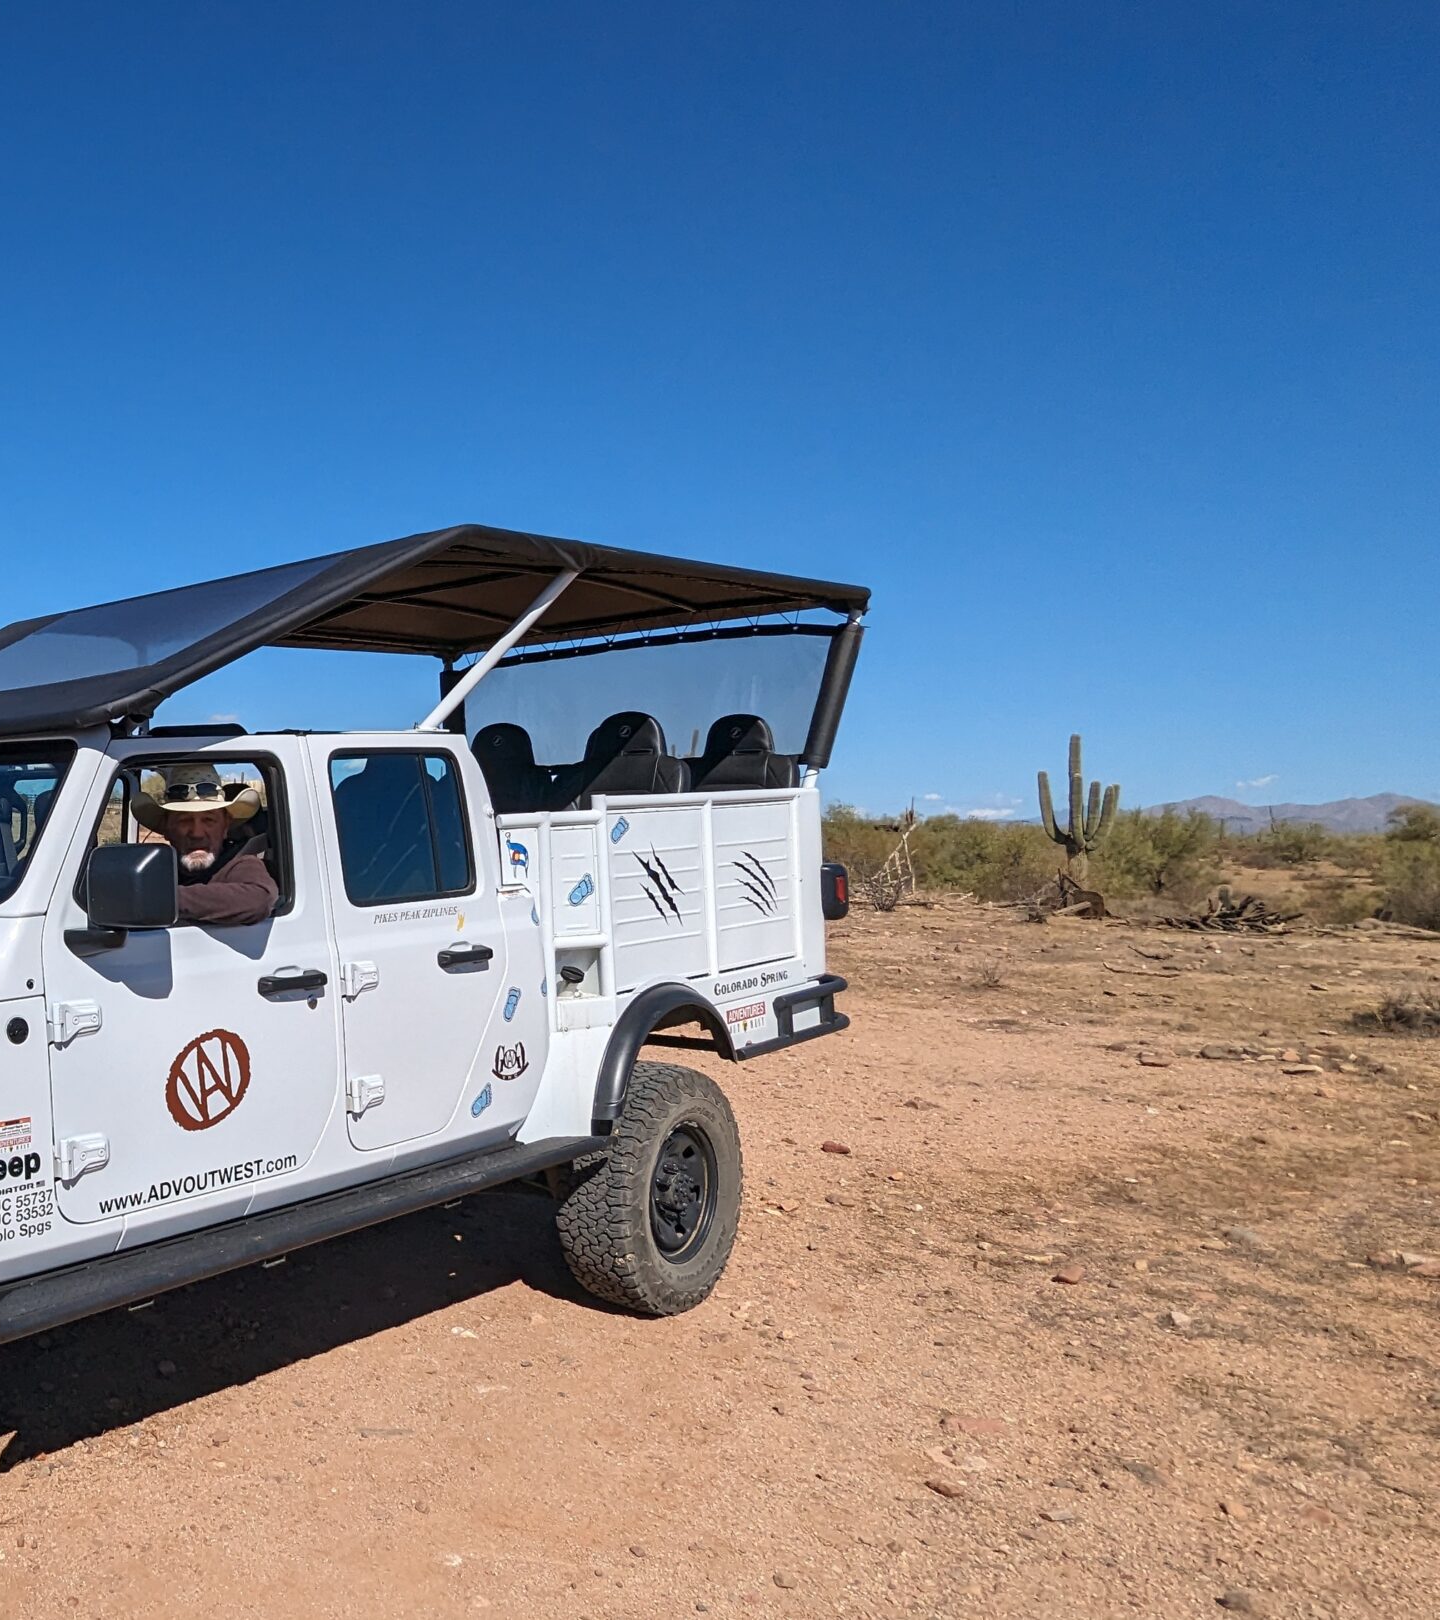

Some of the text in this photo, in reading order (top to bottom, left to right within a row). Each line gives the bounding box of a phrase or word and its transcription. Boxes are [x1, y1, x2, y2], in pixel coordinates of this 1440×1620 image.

[373, 906, 458, 924] PIKES PEAK ZIPLINES
[713, 977, 758, 996] COLORADO
[728, 1003, 765, 1023] ADVENTURES
[98, 1154, 297, 1214] www.ADVOUTWEST.com
[15, 1189, 53, 1209] 55737
[15, 1203, 54, 1222] 53532
[19, 1220, 52, 1238] Spgs
